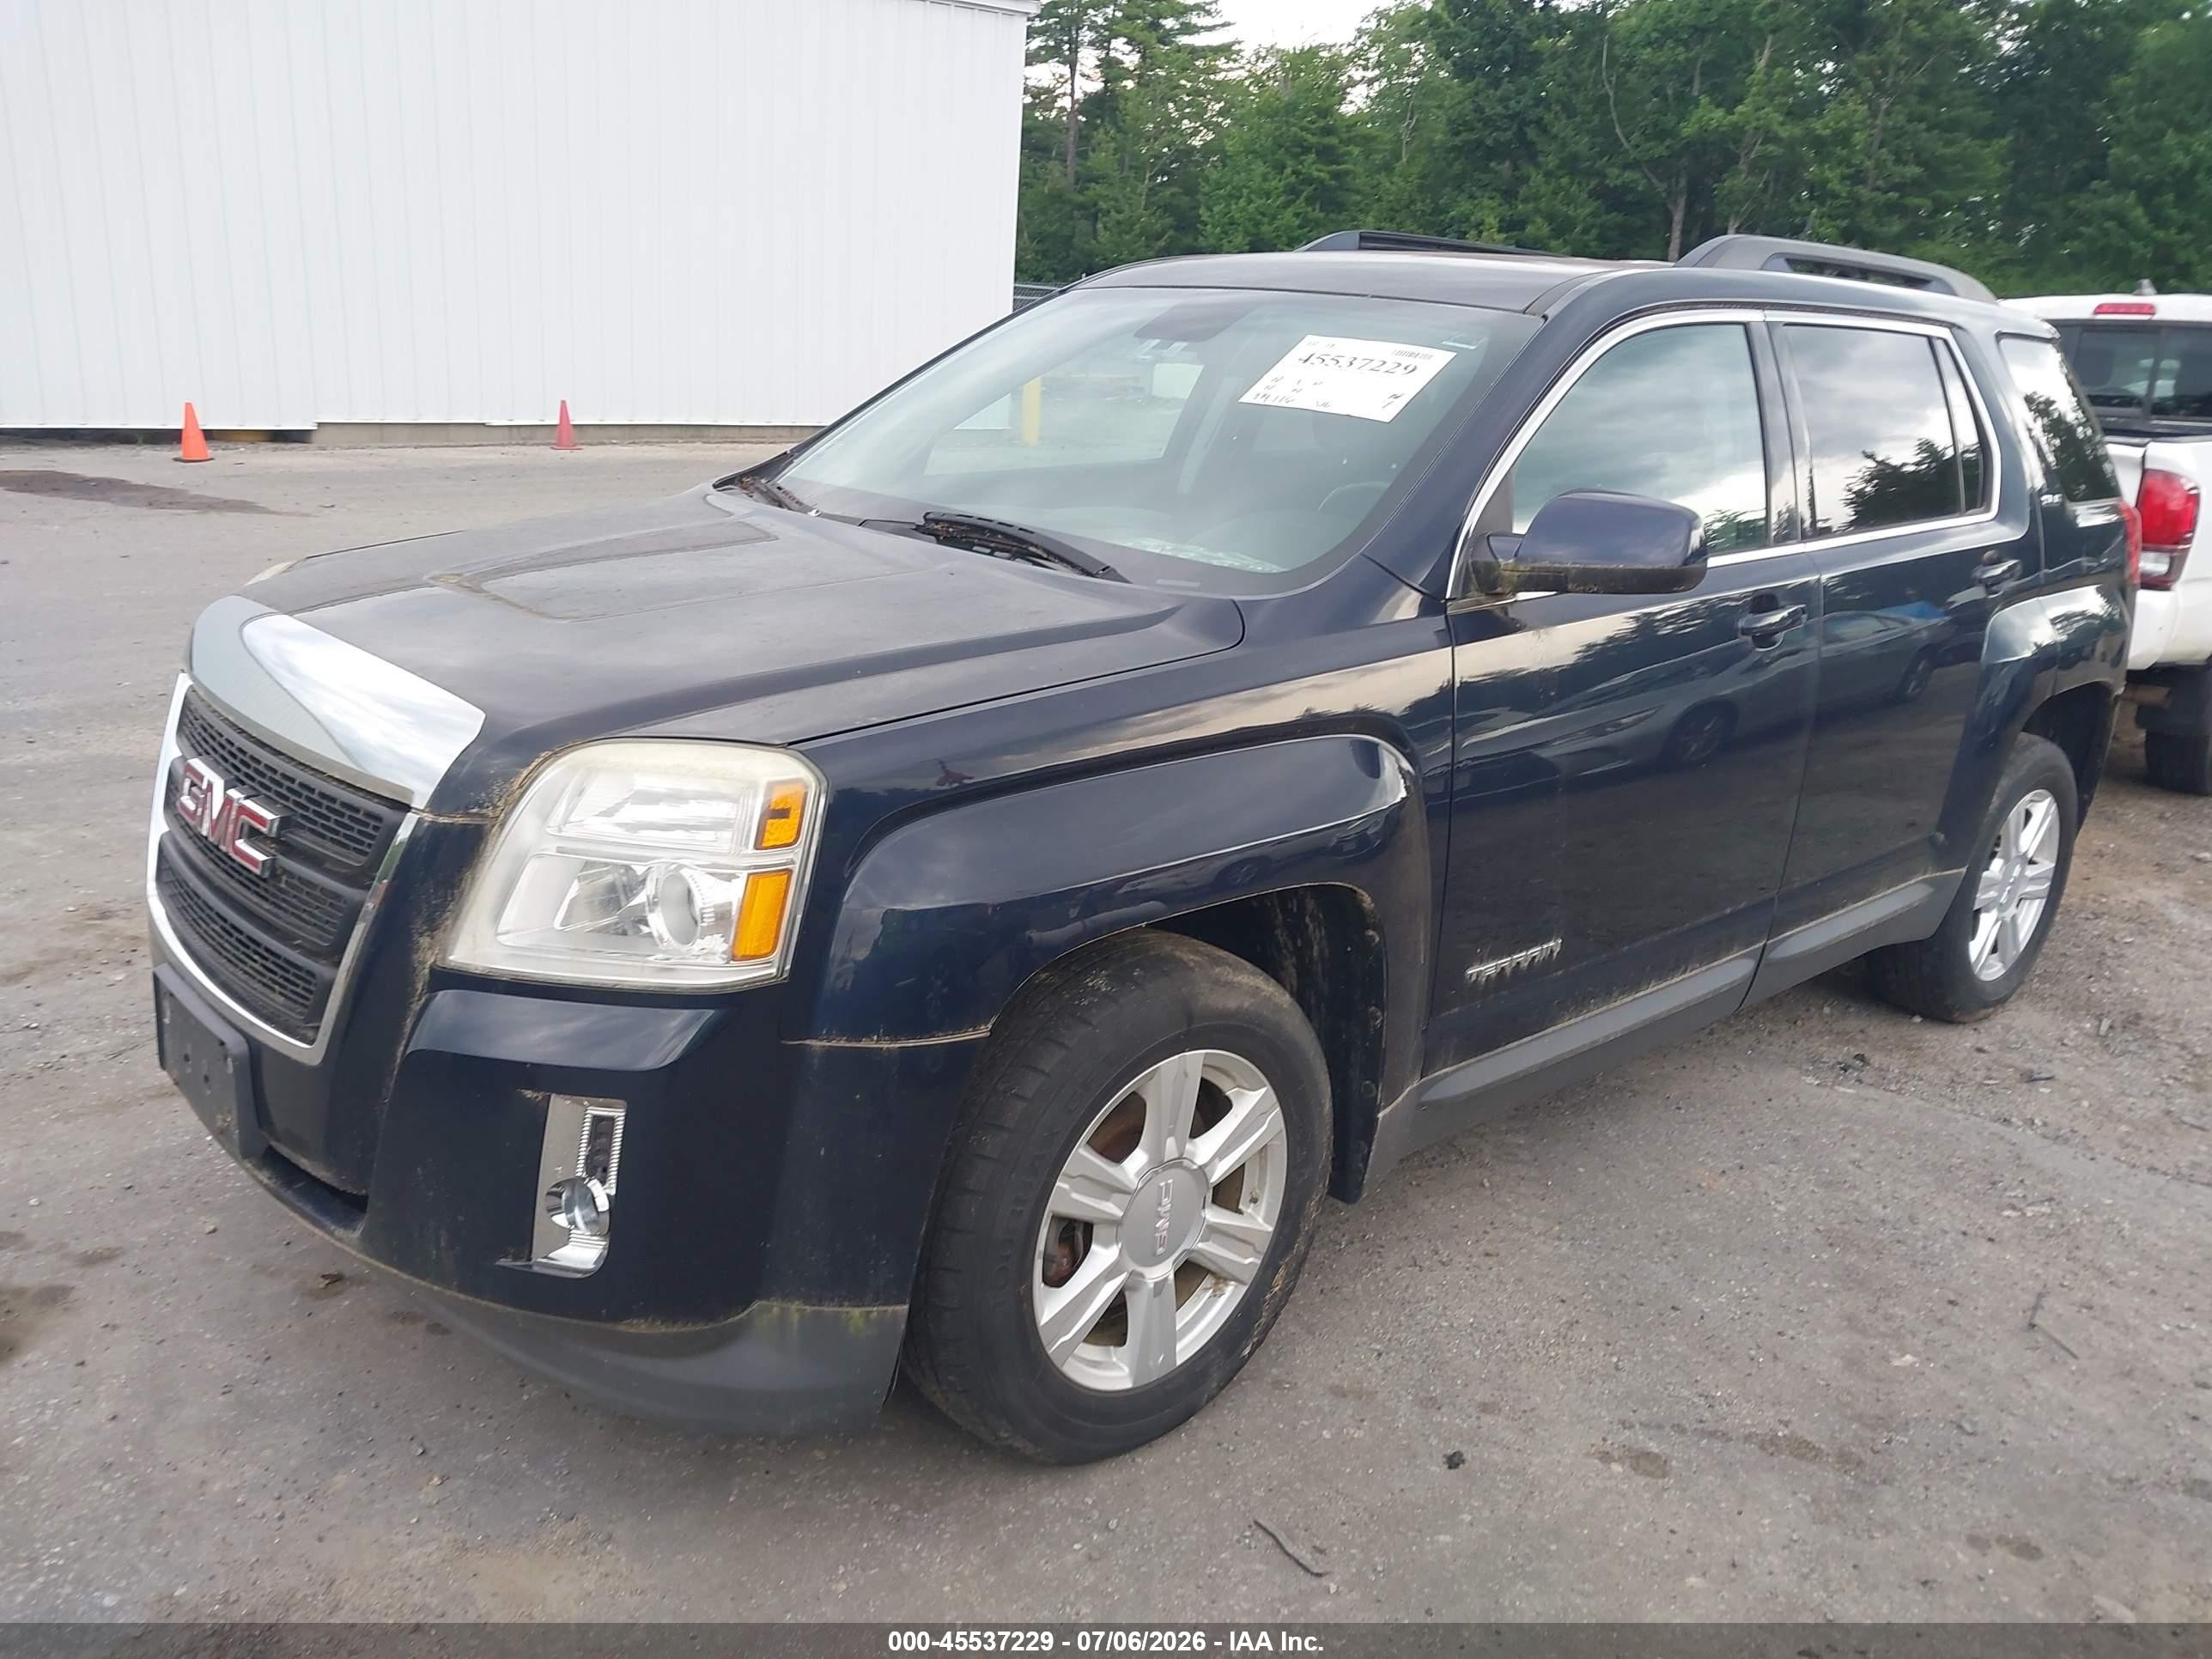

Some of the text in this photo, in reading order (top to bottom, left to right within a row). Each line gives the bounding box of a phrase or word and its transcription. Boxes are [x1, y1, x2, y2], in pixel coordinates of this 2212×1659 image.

[1297, 352, 1419, 375] 45537229
[177, 757, 280, 878] GMC
[1154, 1178, 1174, 1255] GMC
